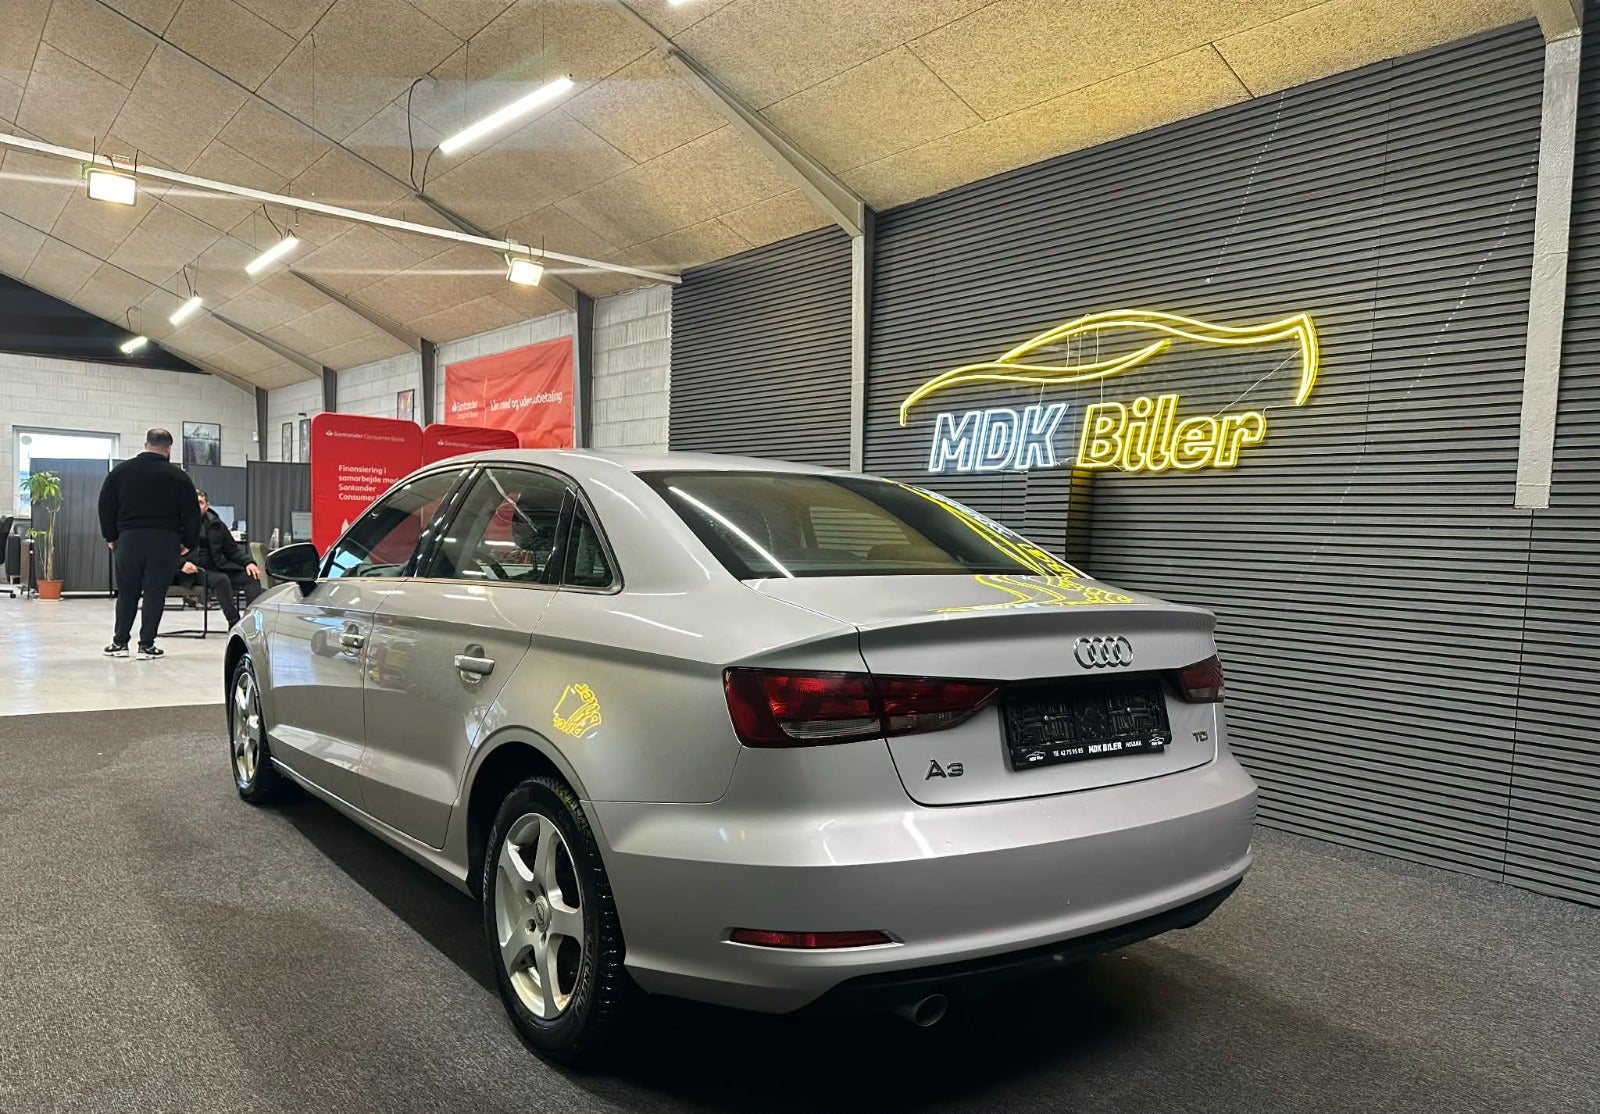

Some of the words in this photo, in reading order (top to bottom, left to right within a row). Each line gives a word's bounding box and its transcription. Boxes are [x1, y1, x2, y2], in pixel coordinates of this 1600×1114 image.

[334, 430, 362, 438] Santander
[928, 402, 1068, 473] MDK
[1076, 393, 1266, 473] Biler
[339, 465, 382, 475] Finansiering
[339, 475, 381, 484] samarbejde
[339, 493, 375, 501] Consumer
[1088, 744, 1102, 754] MDK
[1102, 742, 1122, 752] BILER
[925, 759, 964, 780] A3
